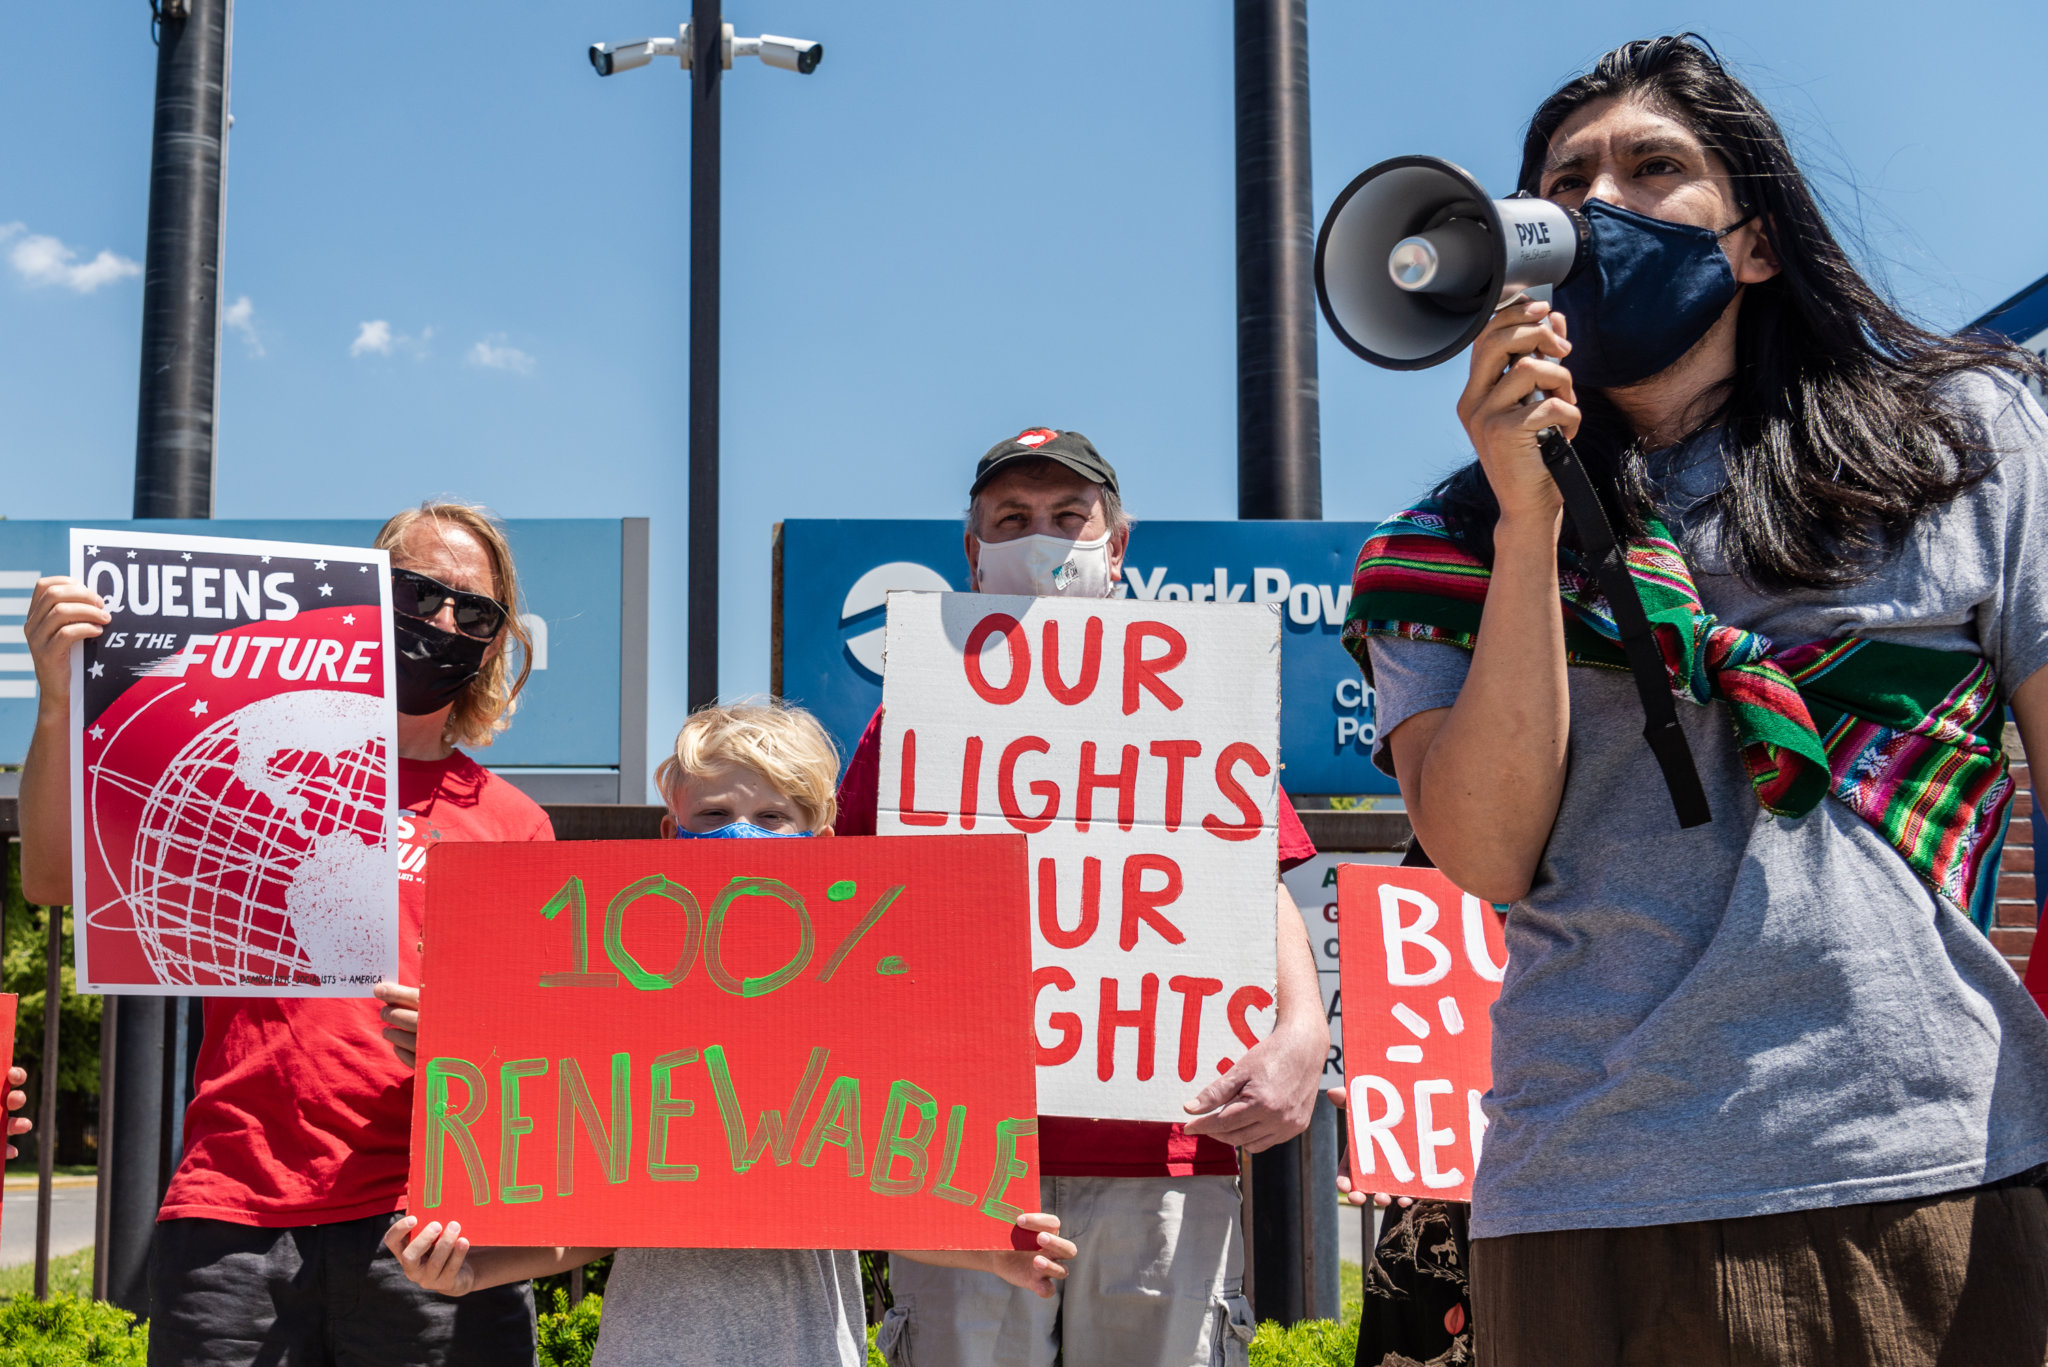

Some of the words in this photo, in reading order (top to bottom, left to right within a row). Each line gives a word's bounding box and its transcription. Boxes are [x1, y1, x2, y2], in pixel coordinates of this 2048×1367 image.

[1515, 222, 1550, 247] PYLE
[87, 560, 300, 622] QUEENS
[1253, 567, 1353, 625] Pow
[105, 632, 129, 648] IS
[134, 633, 177, 649] THE
[170, 634, 380, 683] FUTURE
[963, 613, 1188, 716] OUR
[900, 728, 1271, 841] LIGHTS
[539, 873, 910, 998] 100%
[1038, 853, 1186, 952] UR
[1378, 884, 1510, 986] BU
[239, 974, 292, 985] DEMOCRATIC
[295, 974, 337, 985] SOCIALISTS
[349, 974, 383, 984] AMERICA
[1032, 966, 1274, 1083] GHTS
[424, 1045, 1037, 1225] RENEWABLE
